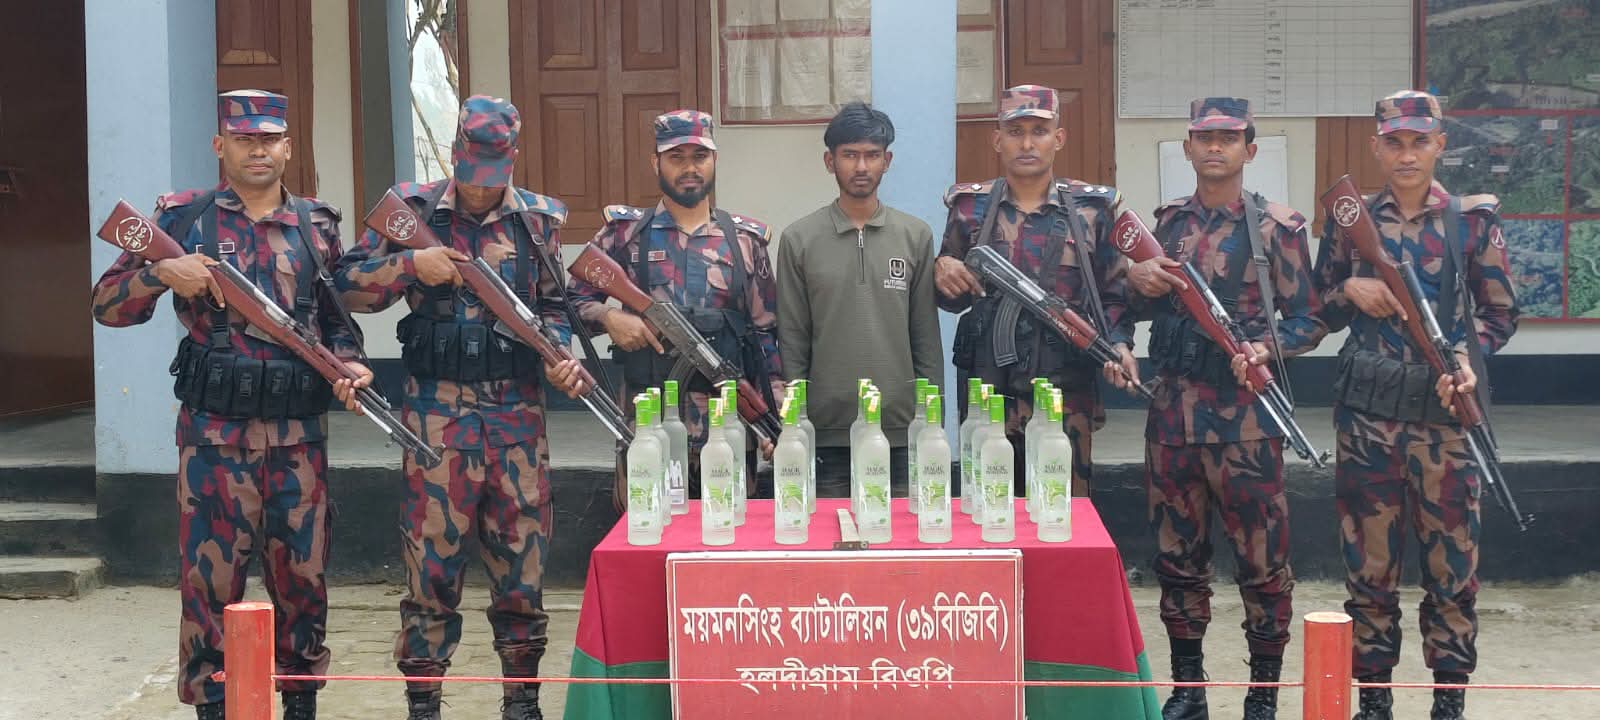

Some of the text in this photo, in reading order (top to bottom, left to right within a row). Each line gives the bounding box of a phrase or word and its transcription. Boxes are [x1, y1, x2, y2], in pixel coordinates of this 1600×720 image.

[680, 591, 1009, 652] ময়মনসিংহ ব্যাটালিয়ন (৩৯বিজিবি)
[735, 657, 955, 694] হলদীগ্রাম বিওপি
